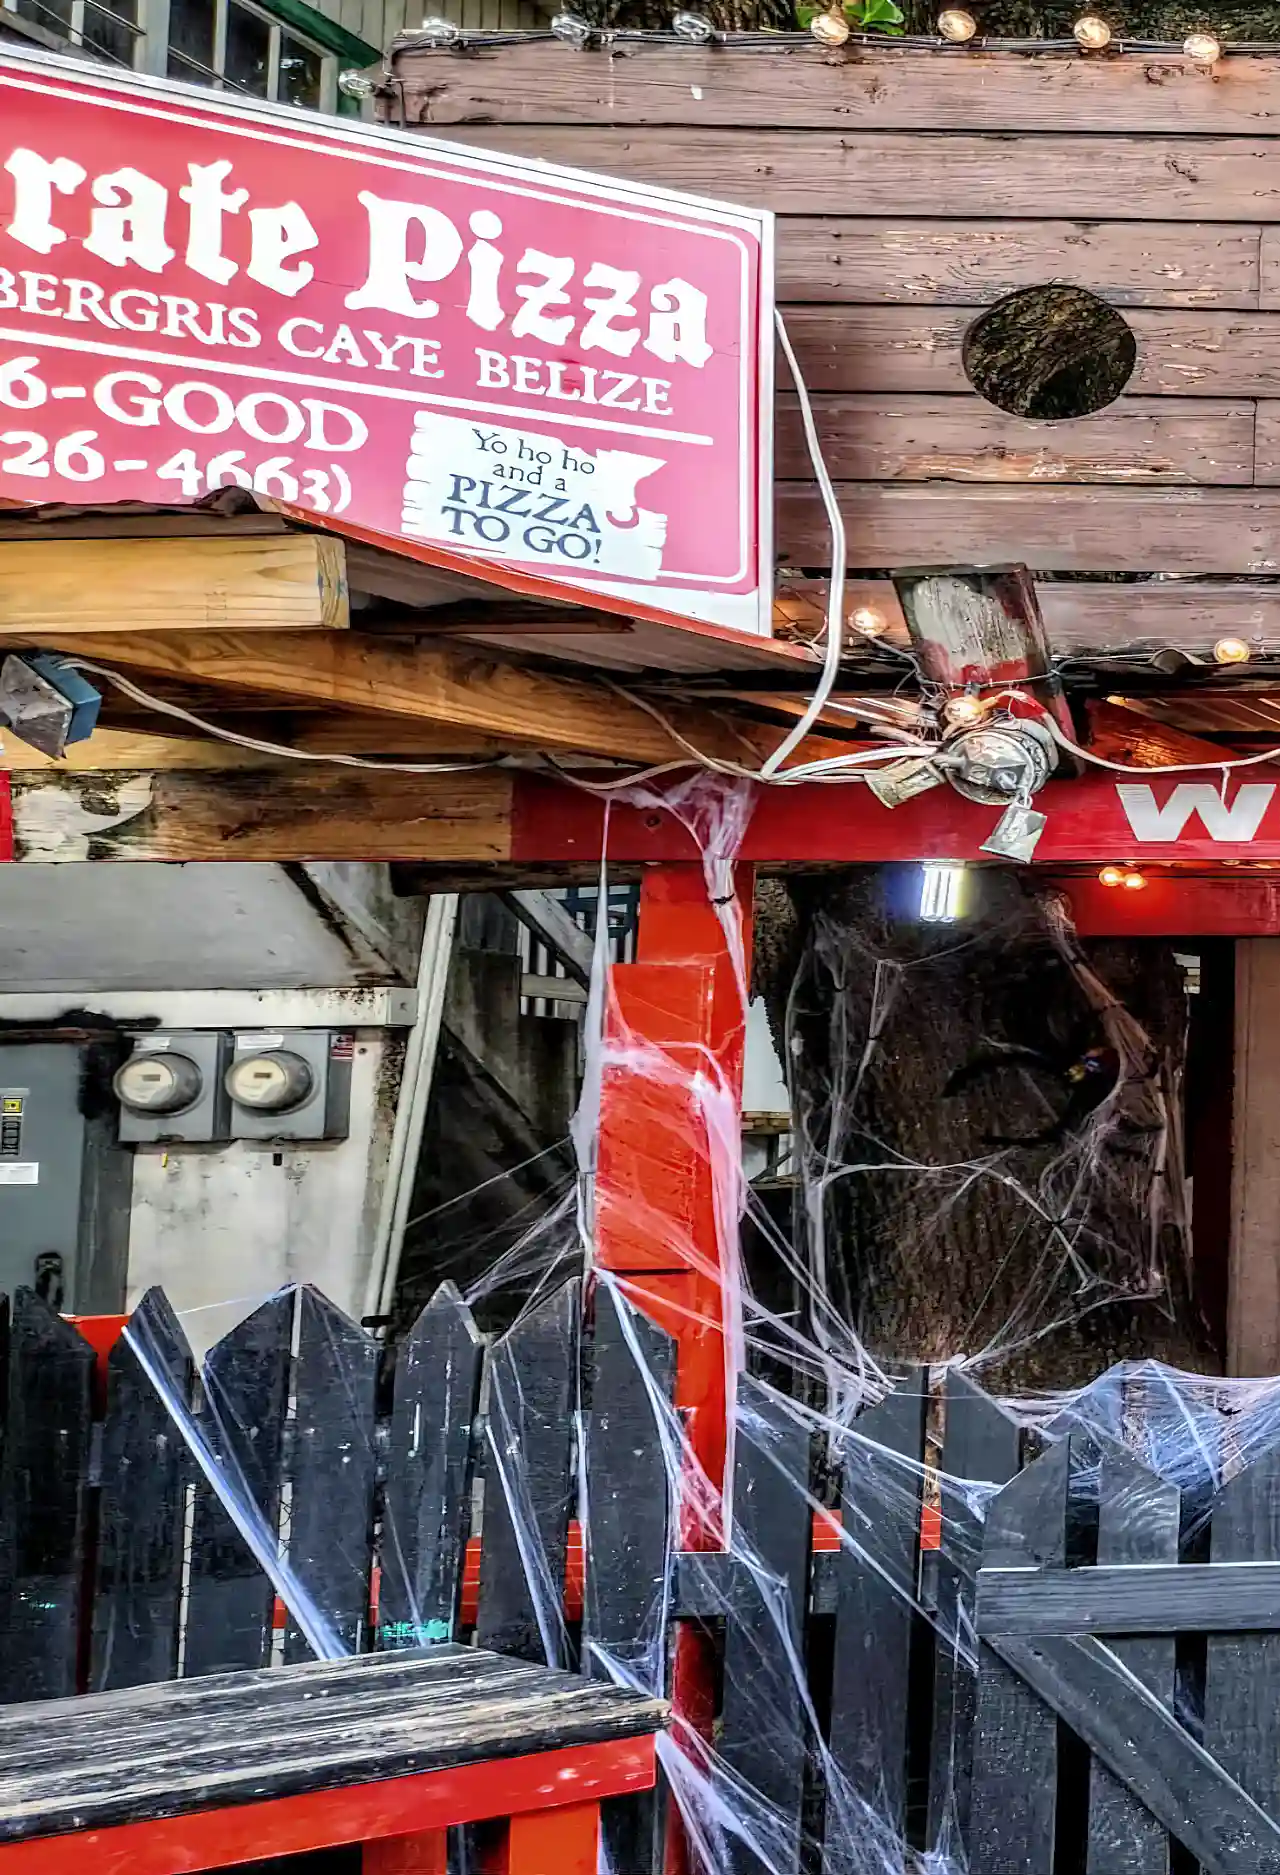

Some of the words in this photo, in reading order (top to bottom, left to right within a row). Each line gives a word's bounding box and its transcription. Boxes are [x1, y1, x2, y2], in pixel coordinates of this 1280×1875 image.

[344, 190, 714, 368] Pizza
[279, 316, 445, 379] CAYE
[474, 347, 674, 416] BELIZE
[472, 428, 508, 455] Yo
[518, 439, 552, 465] ho
[562, 450, 595, 475] ho
[493, 463, 544, 486] and
[554, 477, 568, 492] a
[447, 474, 602, 534] PIZZA
[441, 506, 510, 542] TO
[523, 526, 602, 564] GO!
